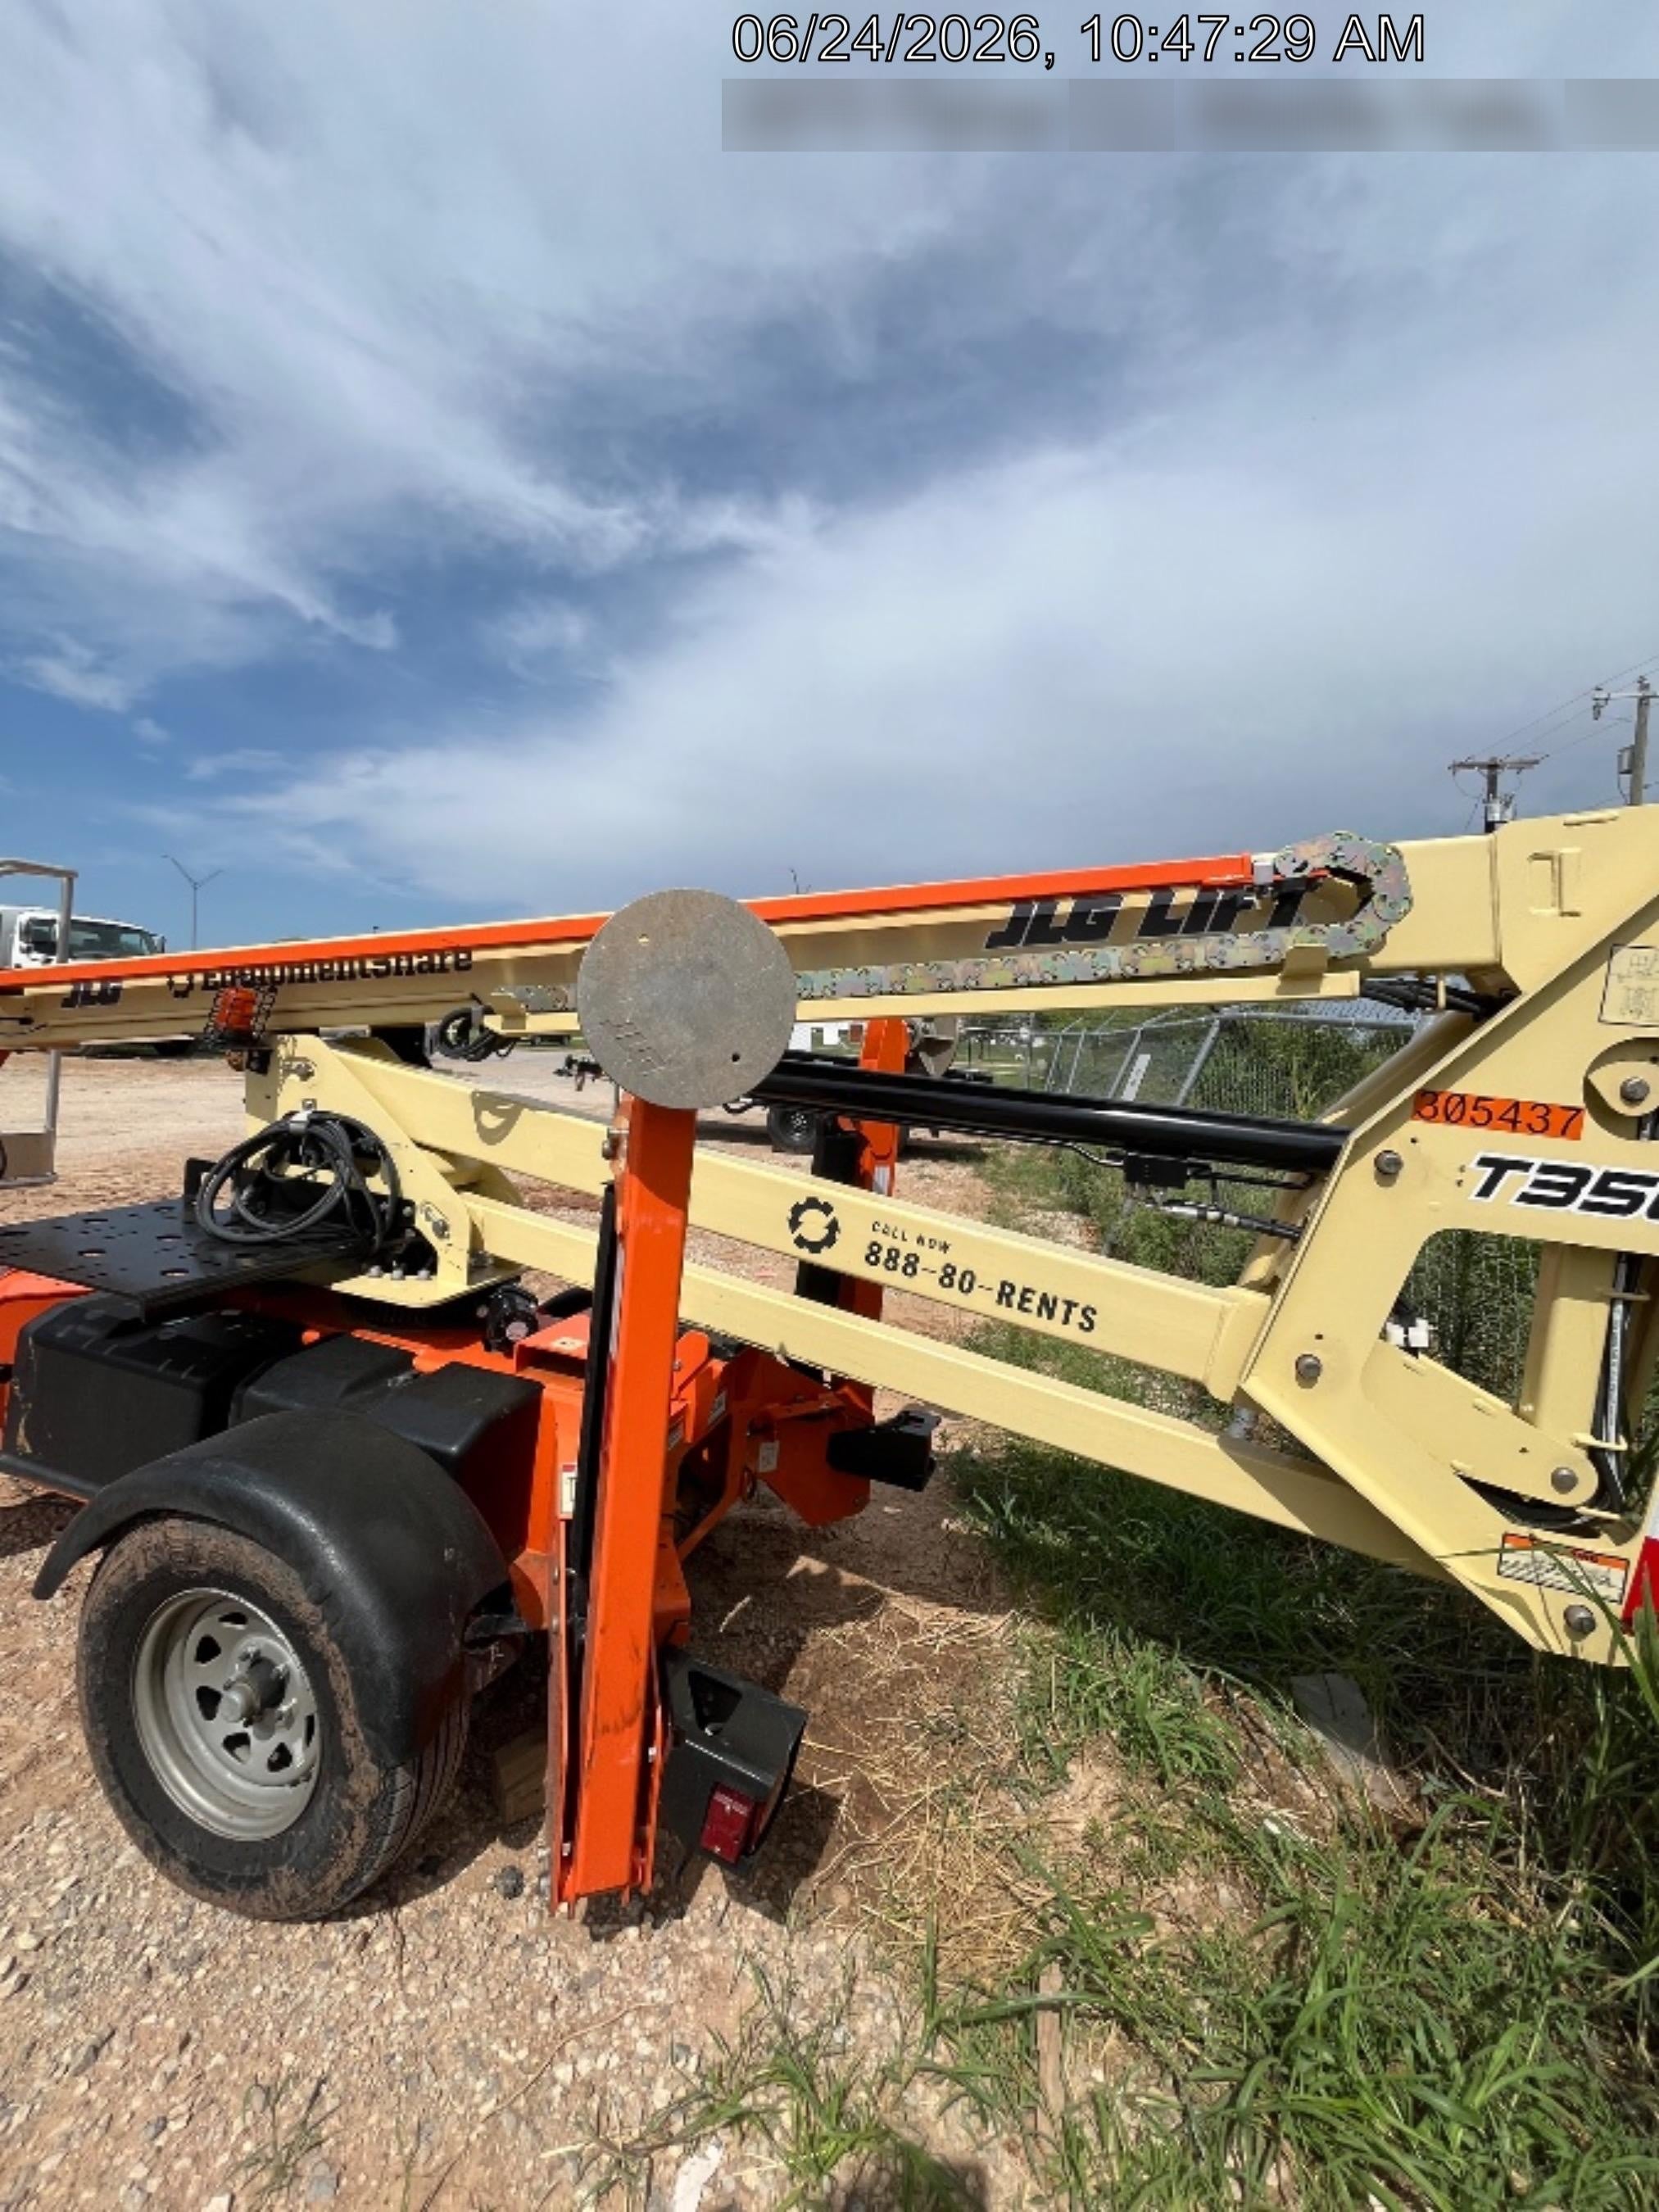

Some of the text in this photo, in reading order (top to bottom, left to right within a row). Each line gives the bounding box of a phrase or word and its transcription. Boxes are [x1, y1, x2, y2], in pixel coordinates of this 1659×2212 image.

[985, 878, 1309, 949] JLG LIFT
[1415, 1090, 1586, 1137] 305437
[1473, 1155, 1659, 1222] T35
[871, 1221, 952, 1254] CALL NOW
